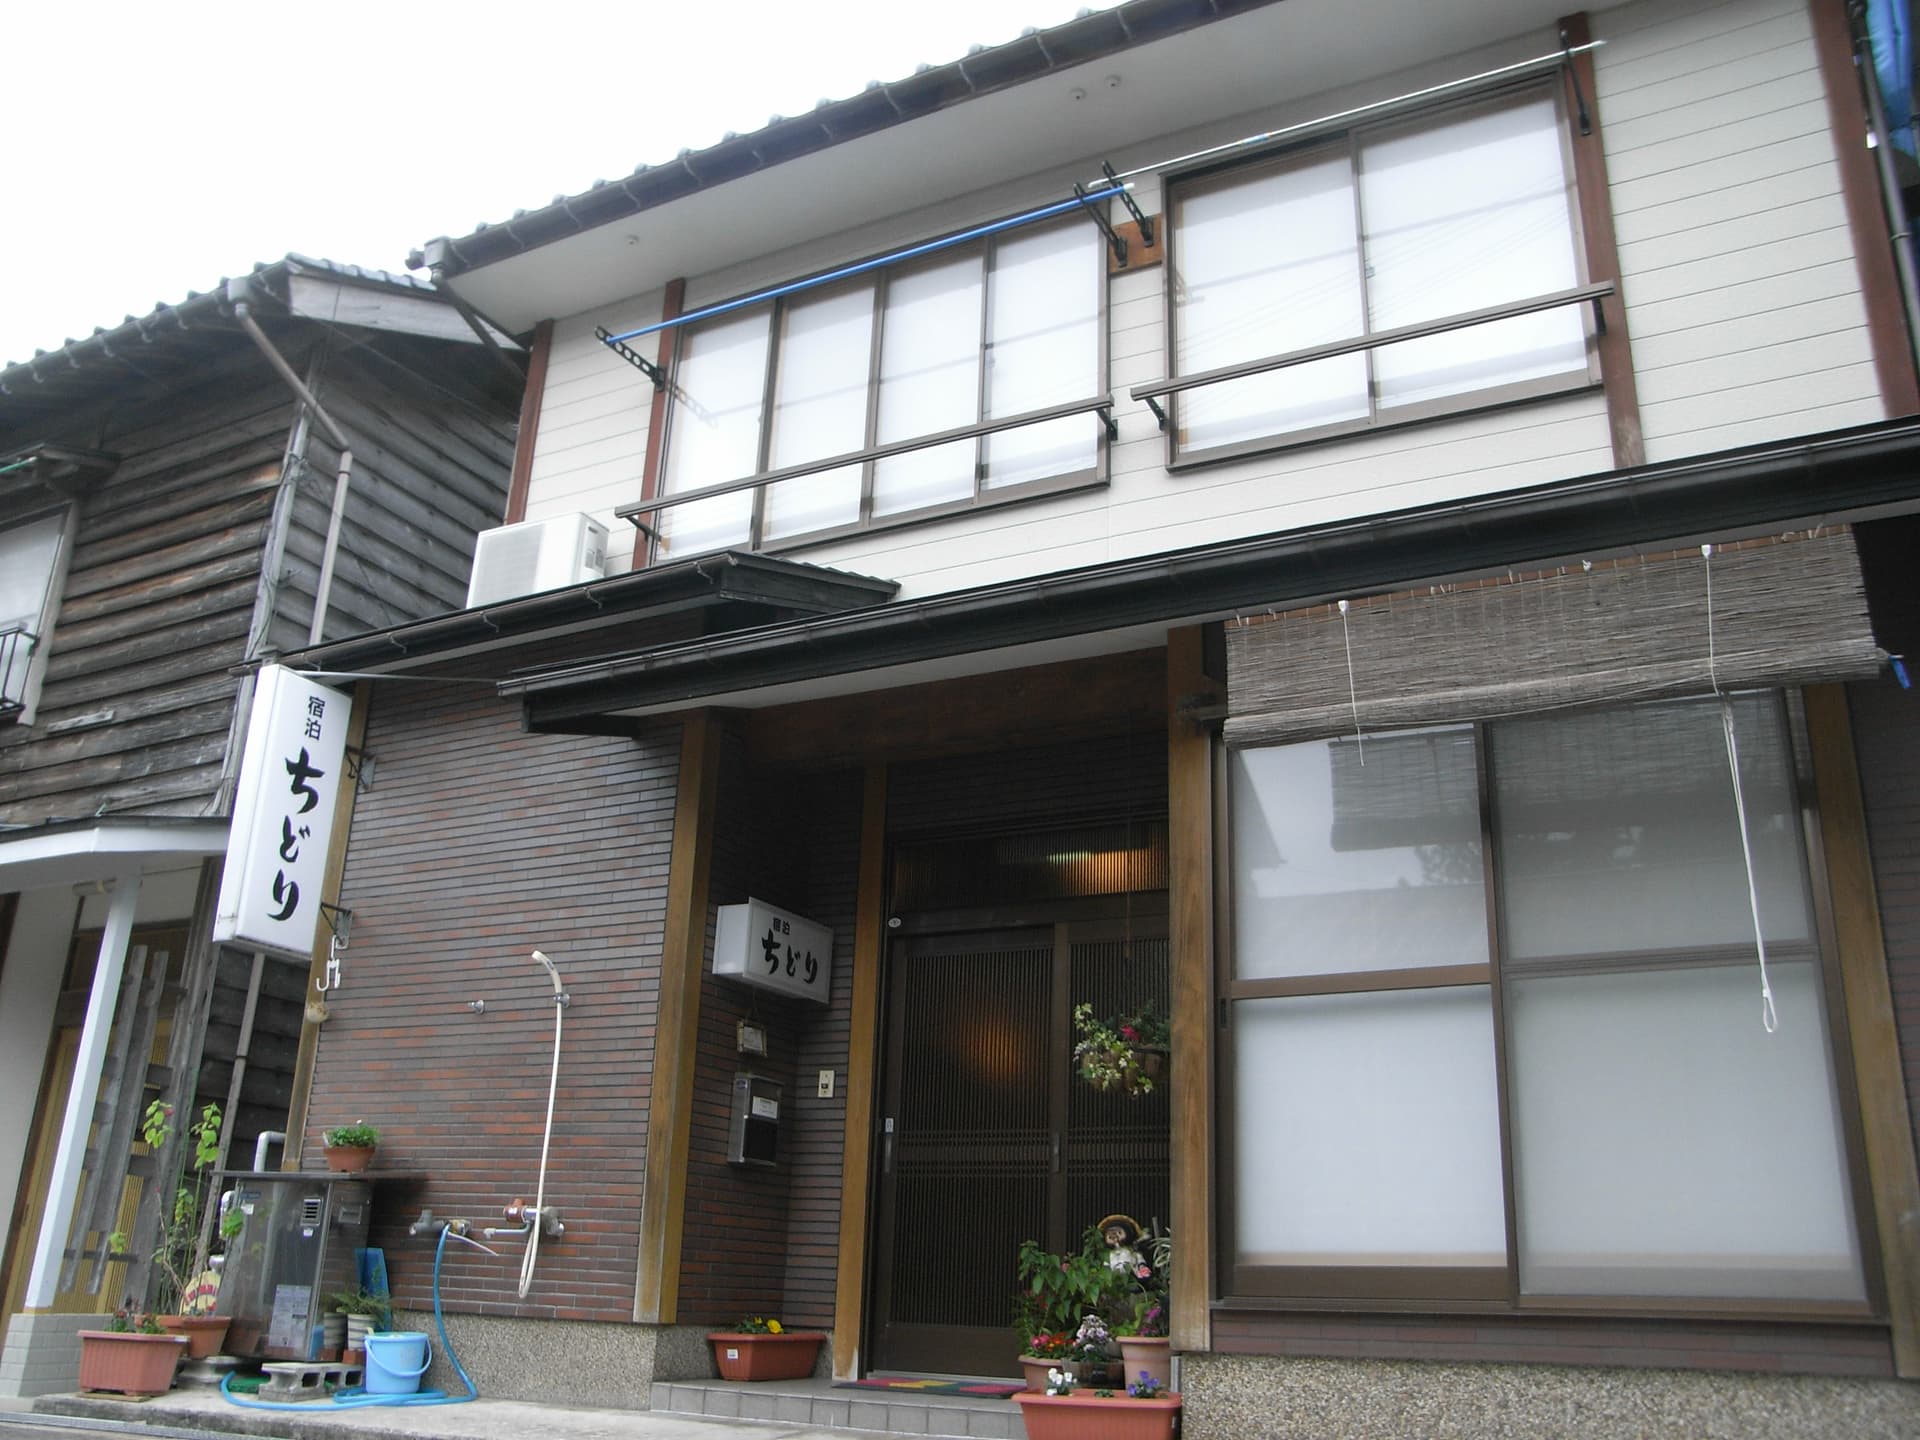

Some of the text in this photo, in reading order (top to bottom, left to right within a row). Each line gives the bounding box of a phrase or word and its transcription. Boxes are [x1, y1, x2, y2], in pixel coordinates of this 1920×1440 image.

[304, 696, 325, 741] 宿泊
[266, 746, 325, 921] ちどり
[761, 928, 818, 984] ちどり
